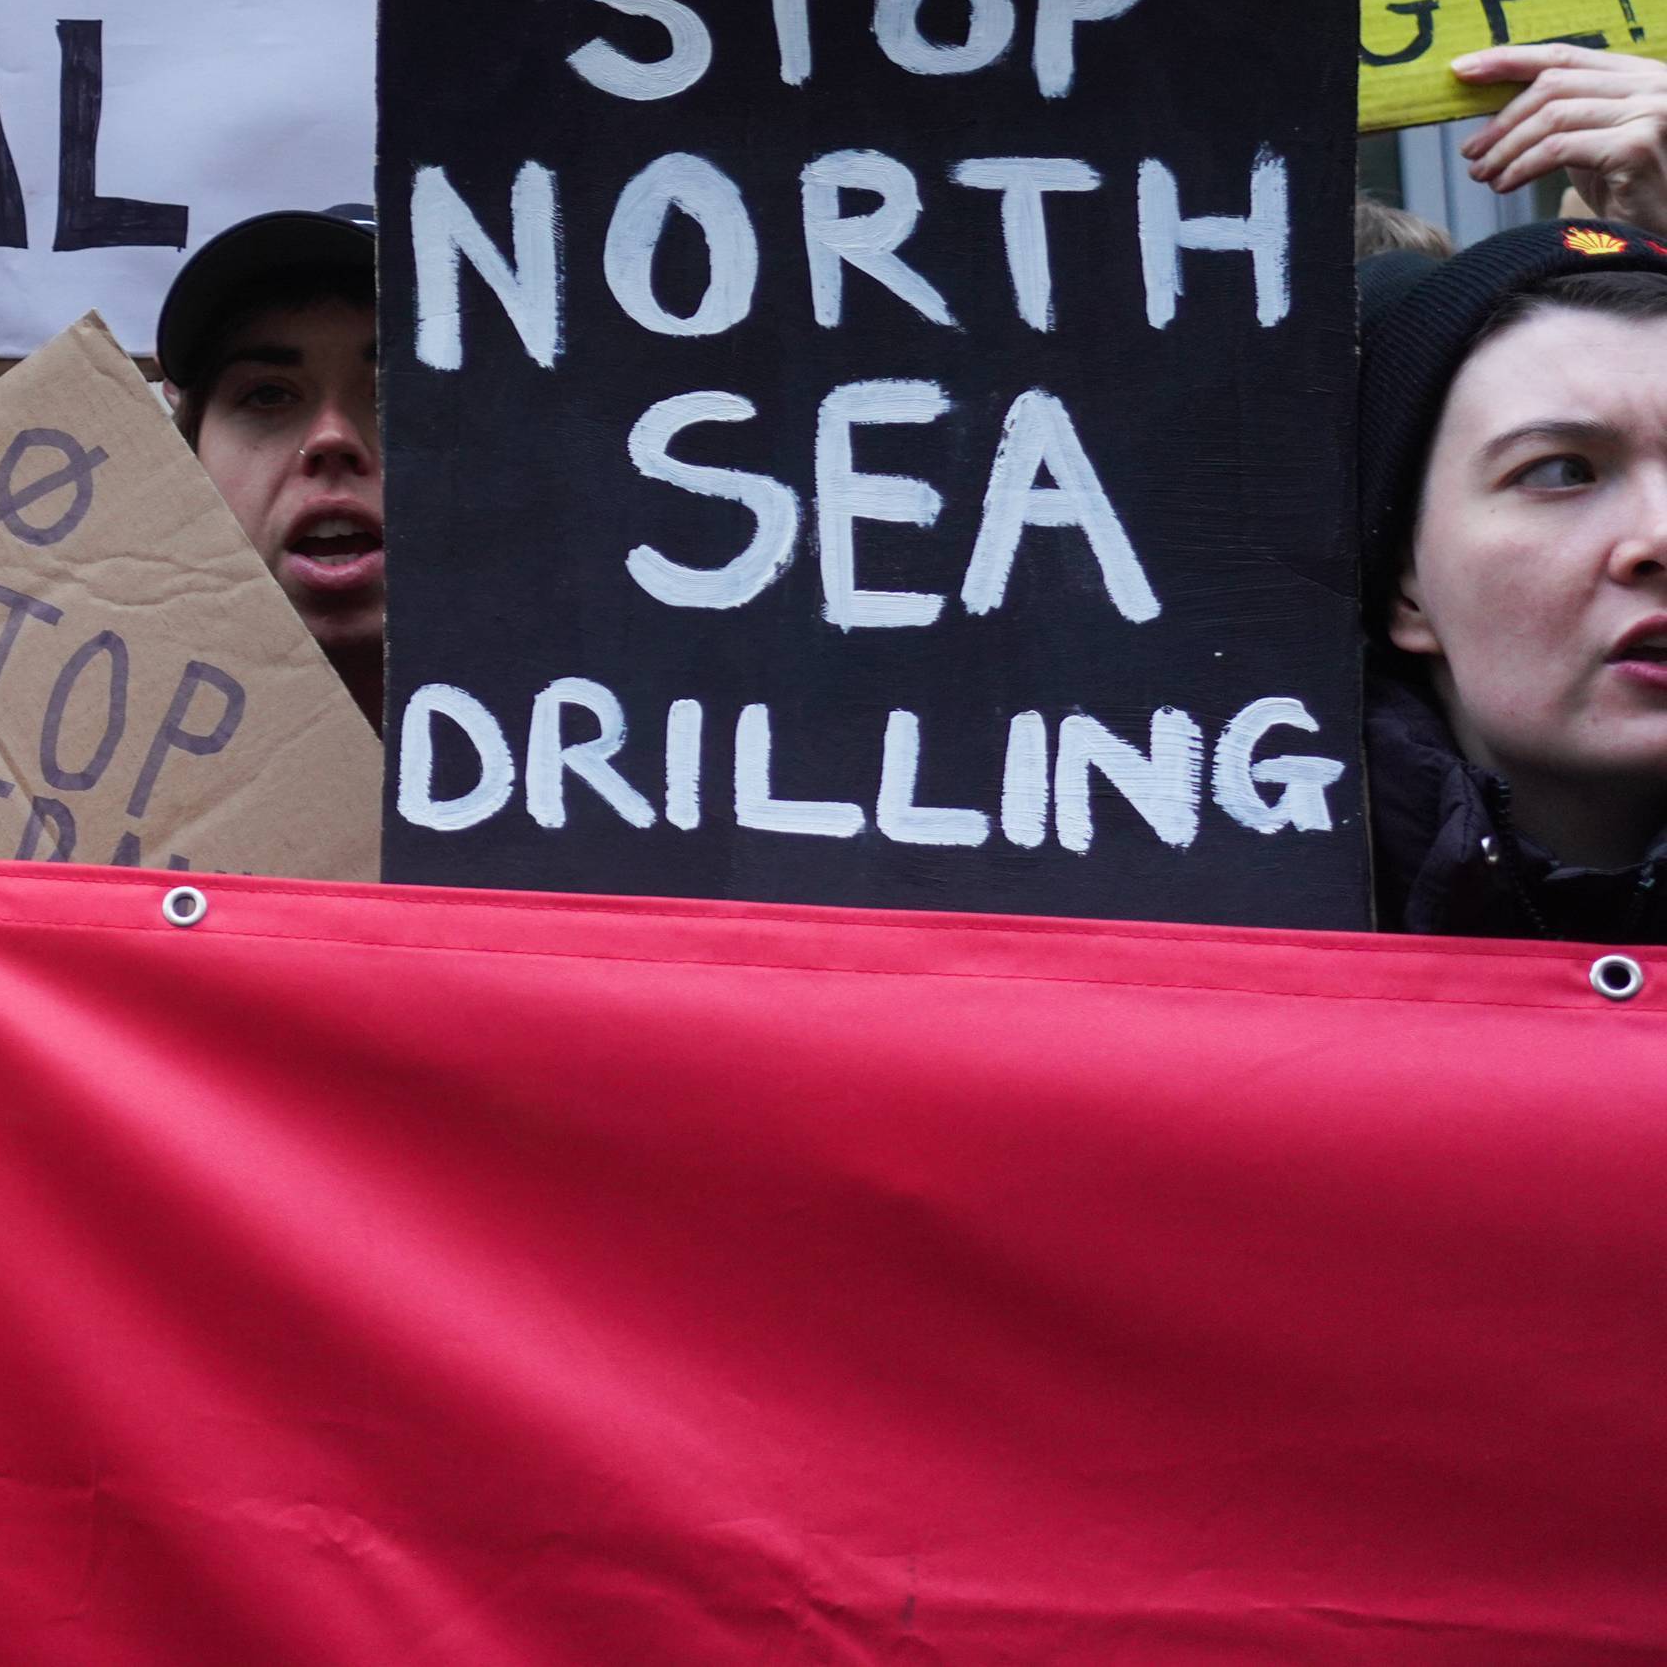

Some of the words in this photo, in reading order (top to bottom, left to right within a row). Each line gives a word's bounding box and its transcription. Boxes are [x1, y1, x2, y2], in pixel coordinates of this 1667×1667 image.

[410, 141, 1291, 372] NORTH
[625, 376, 1162, 633] SEA
[397, 675, 1346, 855] DRILLING
